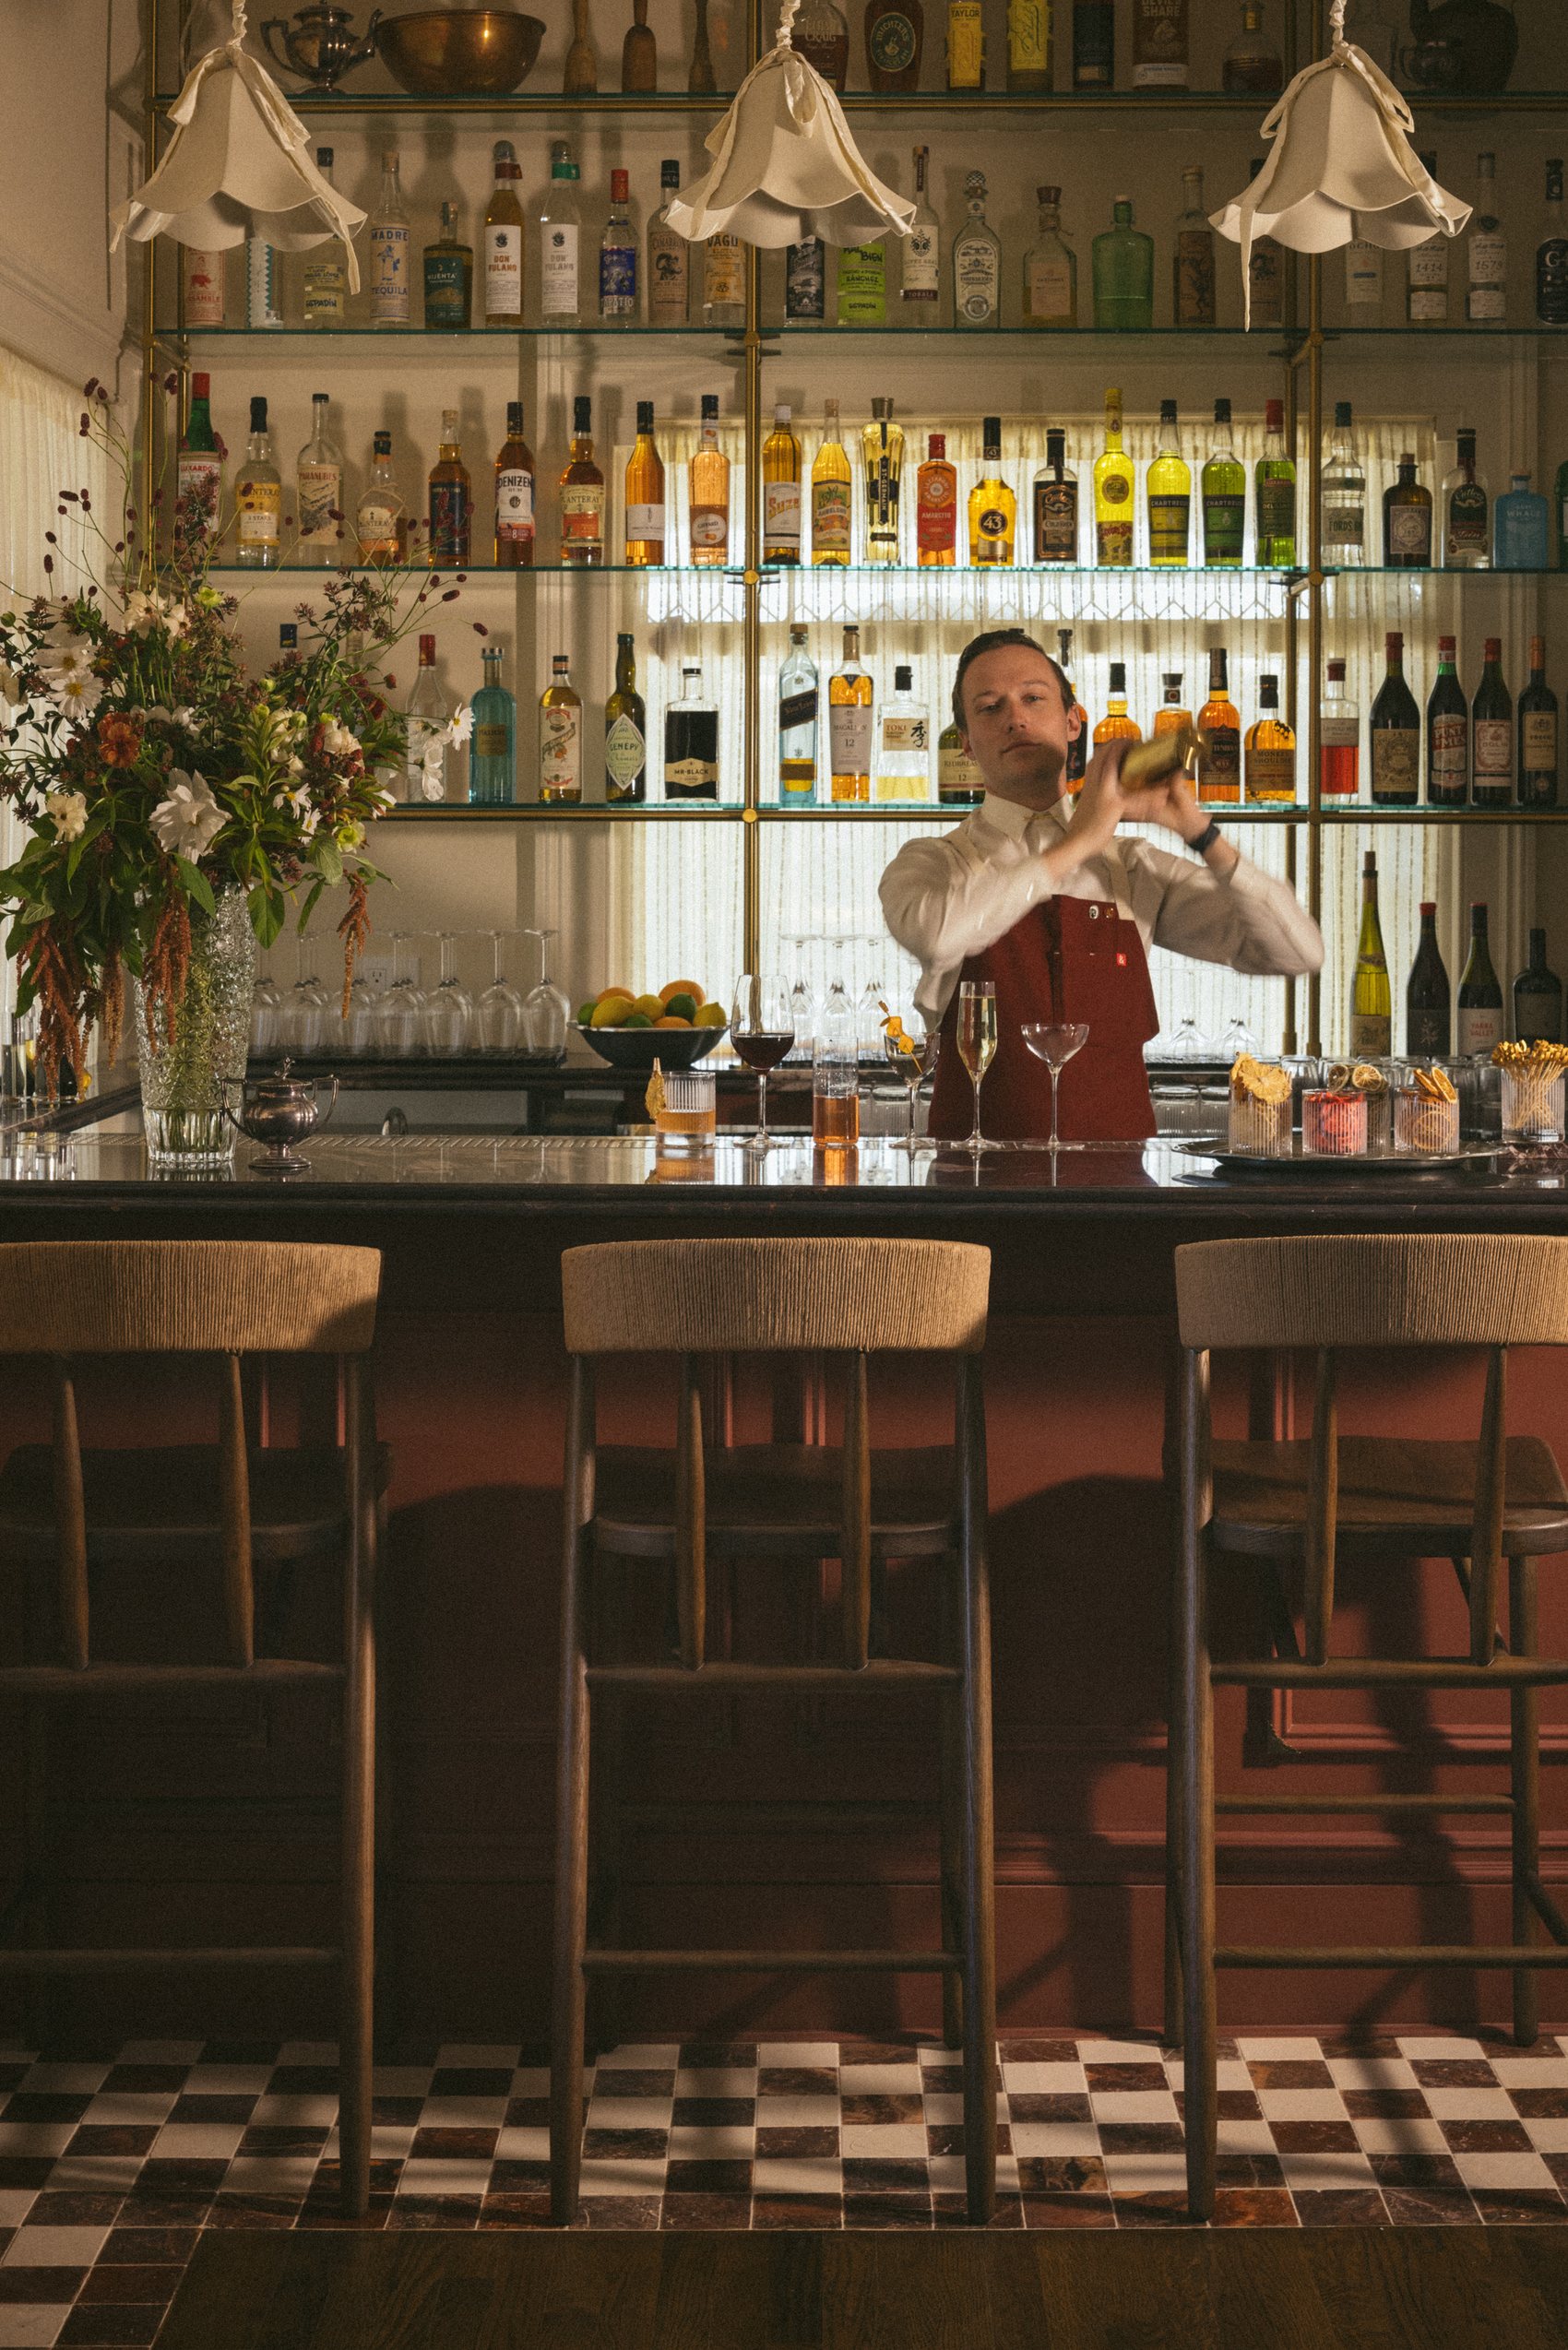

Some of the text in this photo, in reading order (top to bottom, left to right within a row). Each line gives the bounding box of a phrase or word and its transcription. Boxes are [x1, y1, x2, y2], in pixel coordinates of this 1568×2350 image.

[951, 8, 980, 18] TAYLOR
[1142, 6, 1180, 17] SHARE
[805, 30, 837, 42] CRAIG
[371, 231, 408, 241] MADRE
[488, 264, 517, 272] FULANO
[371, 287, 409, 295] TEQUILA
[498, 476, 532, 488] DENIZEN
[983, 516, 1003, 530] 43
[1329, 520, 1353, 532] FORDS
[512, 529, 517, 539] 8
[1434, 726, 1464, 739] PUNT
[610, 742, 639, 752] GENEPY
[844, 738, 855, 748] 12
